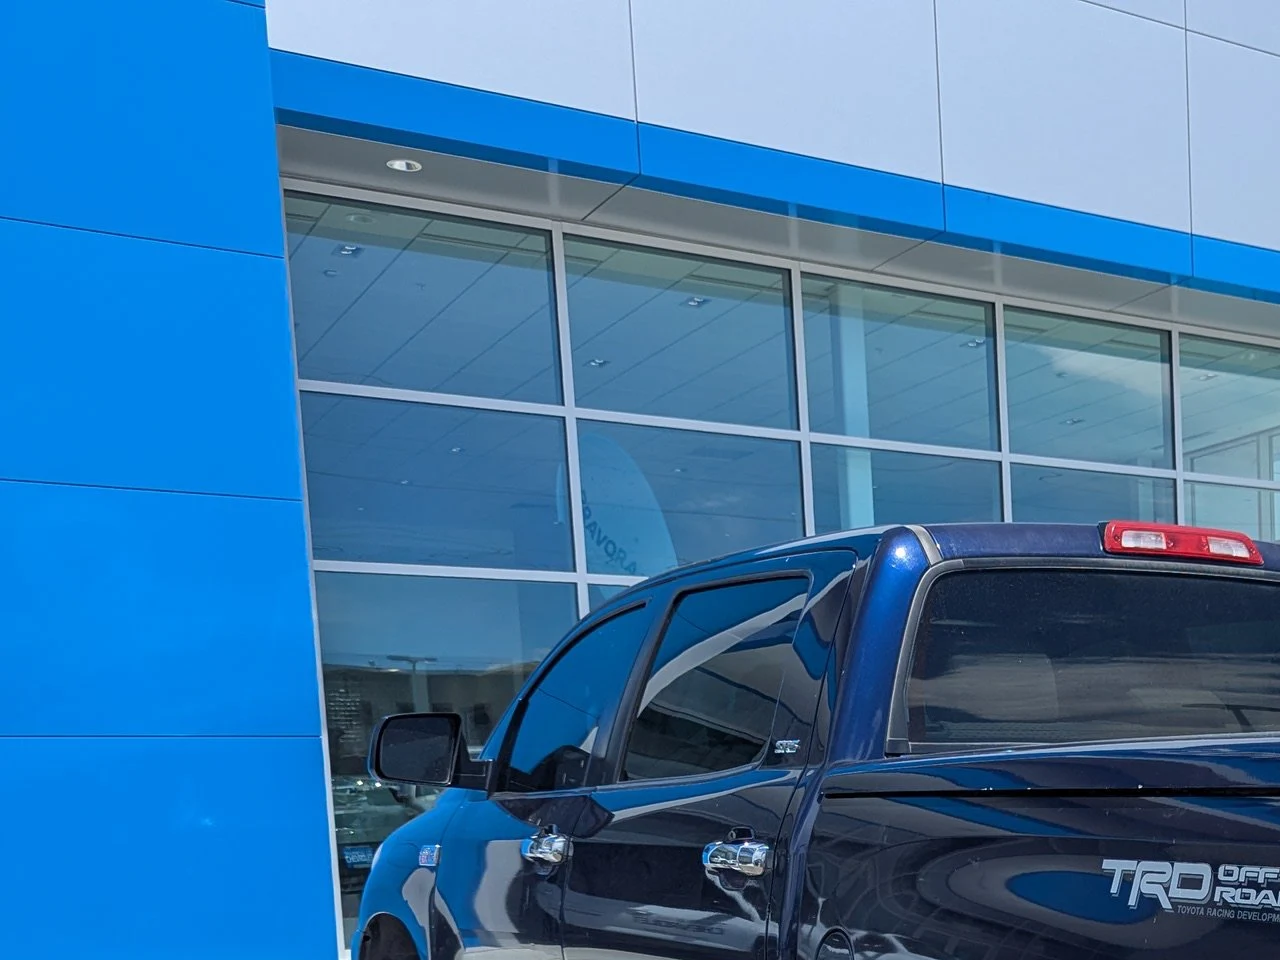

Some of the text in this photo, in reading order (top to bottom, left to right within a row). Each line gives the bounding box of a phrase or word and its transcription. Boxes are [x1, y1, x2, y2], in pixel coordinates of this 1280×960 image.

[1102, 859, 1213, 912] TRD
[1177, 905, 1204, 916] TOYOTA
[1206, 907, 1235, 919] RACING
